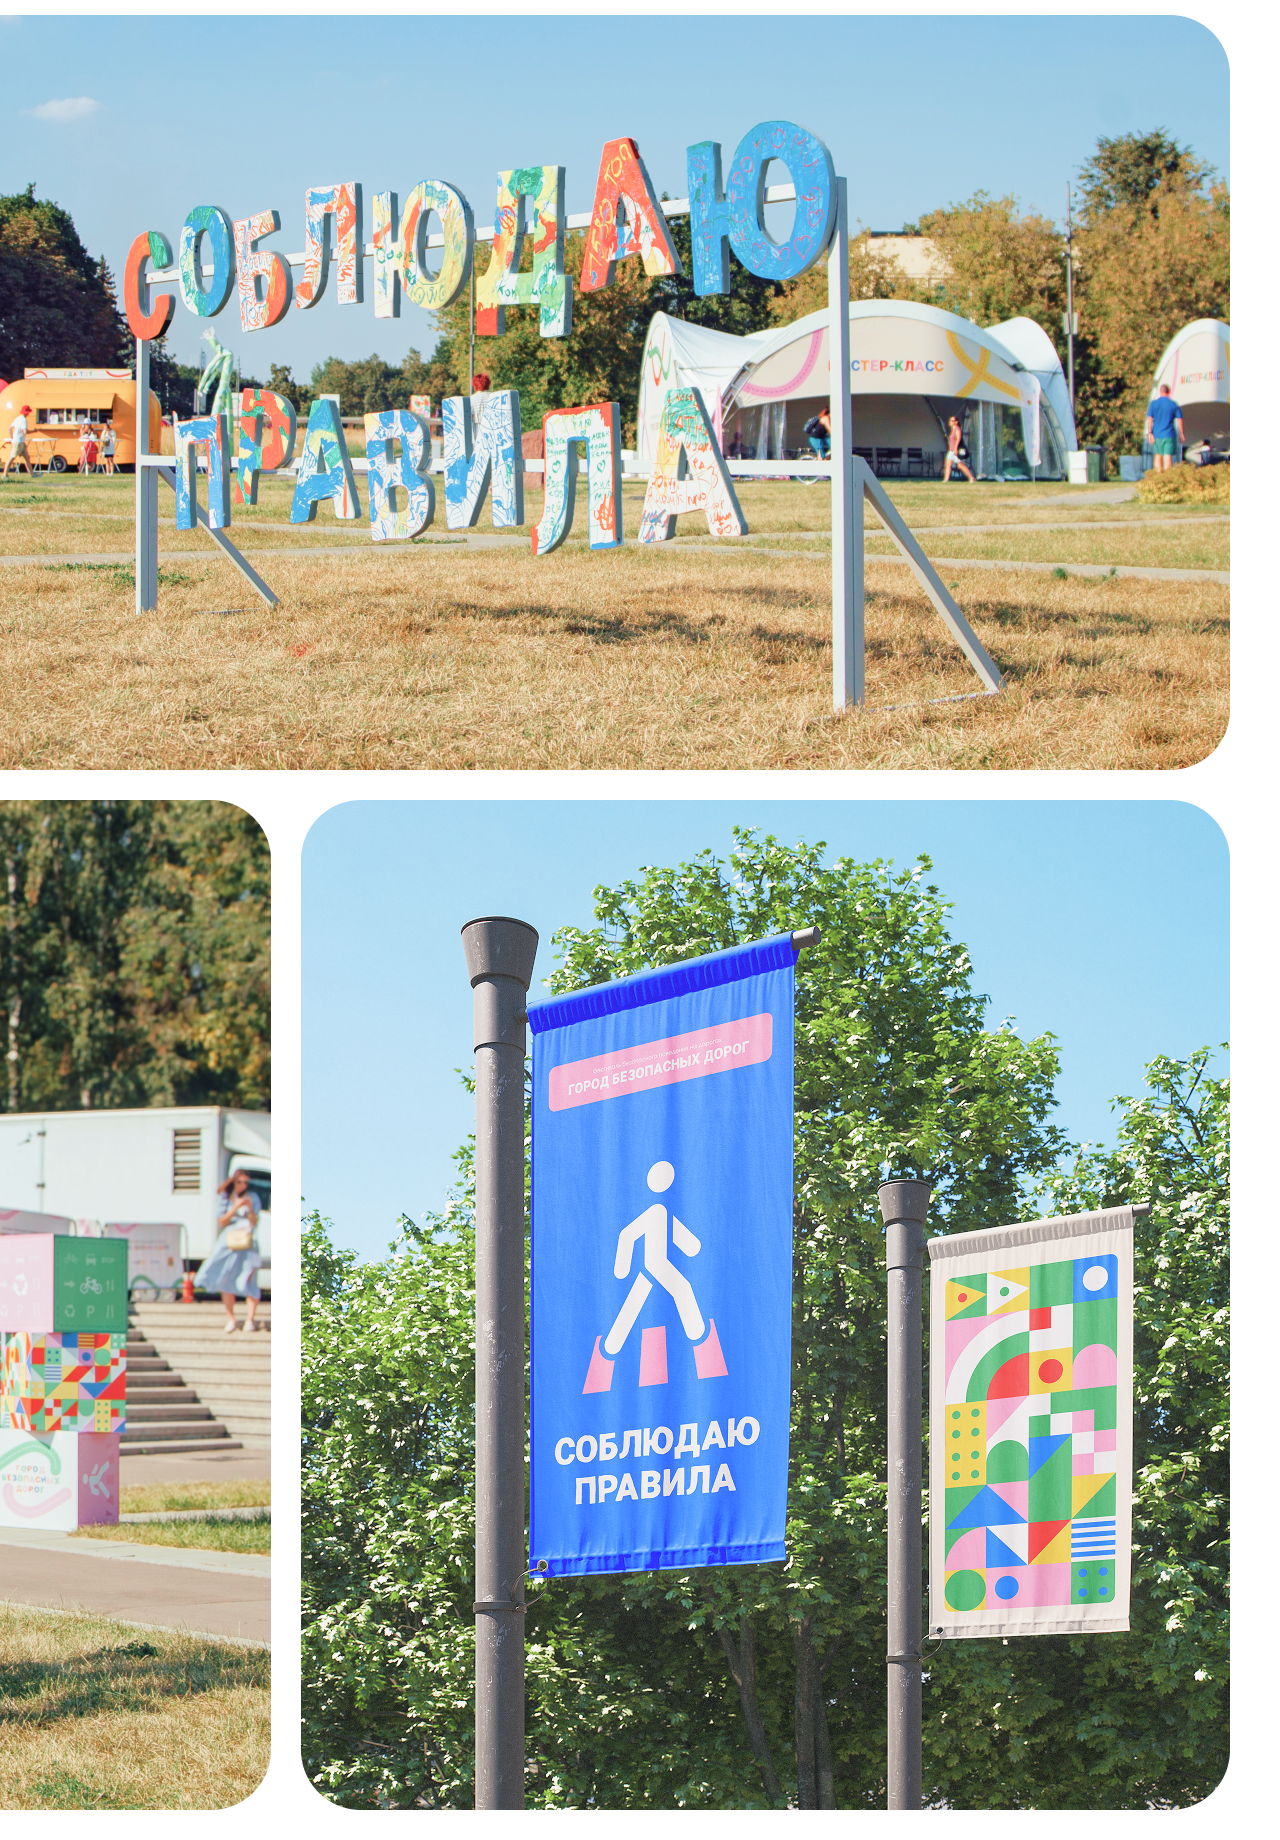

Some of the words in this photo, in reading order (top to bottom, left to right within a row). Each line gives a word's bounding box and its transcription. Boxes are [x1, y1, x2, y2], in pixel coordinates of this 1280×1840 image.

[124, 121, 836, 340] СОБЛЮДАЮ
[828, 360, 944, 372] СТЕР-КЛАСС
[173, 386, 748, 556] ПРАВИЛА
[568, 1074, 610, 1096] ГОРОД
[612, 1054, 701, 1085] БЕЗОПАСНЫХ
[703, 1040, 750, 1066] ДОРОГ
[554, 1416, 761, 1466] СОБЛЮДАЮ
[1, 1474, 60, 1485] БЕЗОПАСНЫХ
[16, 1464, 45, 1474] ГОРОД
[16, 1484, 45, 1493] ДОРОГ
[575, 1463, 737, 1505] ПРАВИЛА
